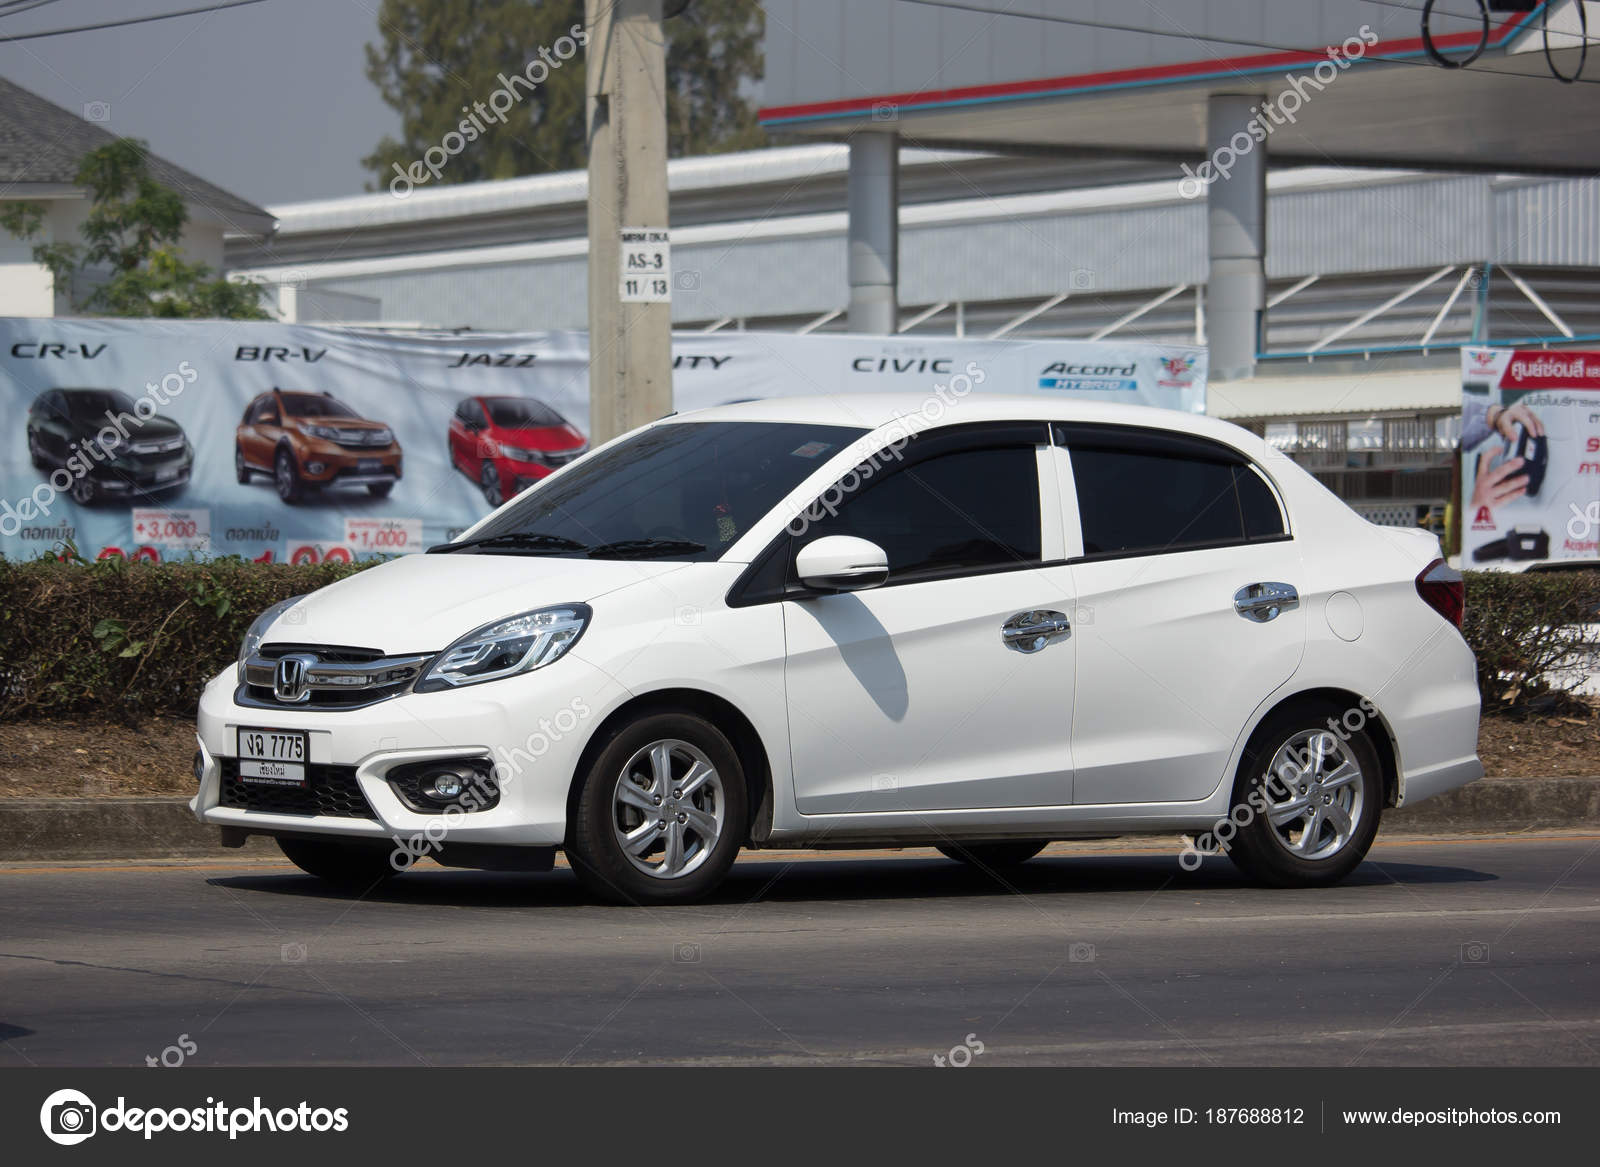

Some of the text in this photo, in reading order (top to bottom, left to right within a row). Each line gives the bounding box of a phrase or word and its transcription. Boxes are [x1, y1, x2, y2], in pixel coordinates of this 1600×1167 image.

[628, 253, 663, 268] AS-3
[653, 280, 667, 295] 13
[11, 343, 106, 359] CR-V
[235, 346, 328, 363] BR-V
[448, 353, 537, 369] JAZZ
[672, 355, 734, 370] ITY
[852, 357, 953, 374] CIVIC
[1041, 362, 1137, 376] Accord
[271, 735, 303, 758] 7775
